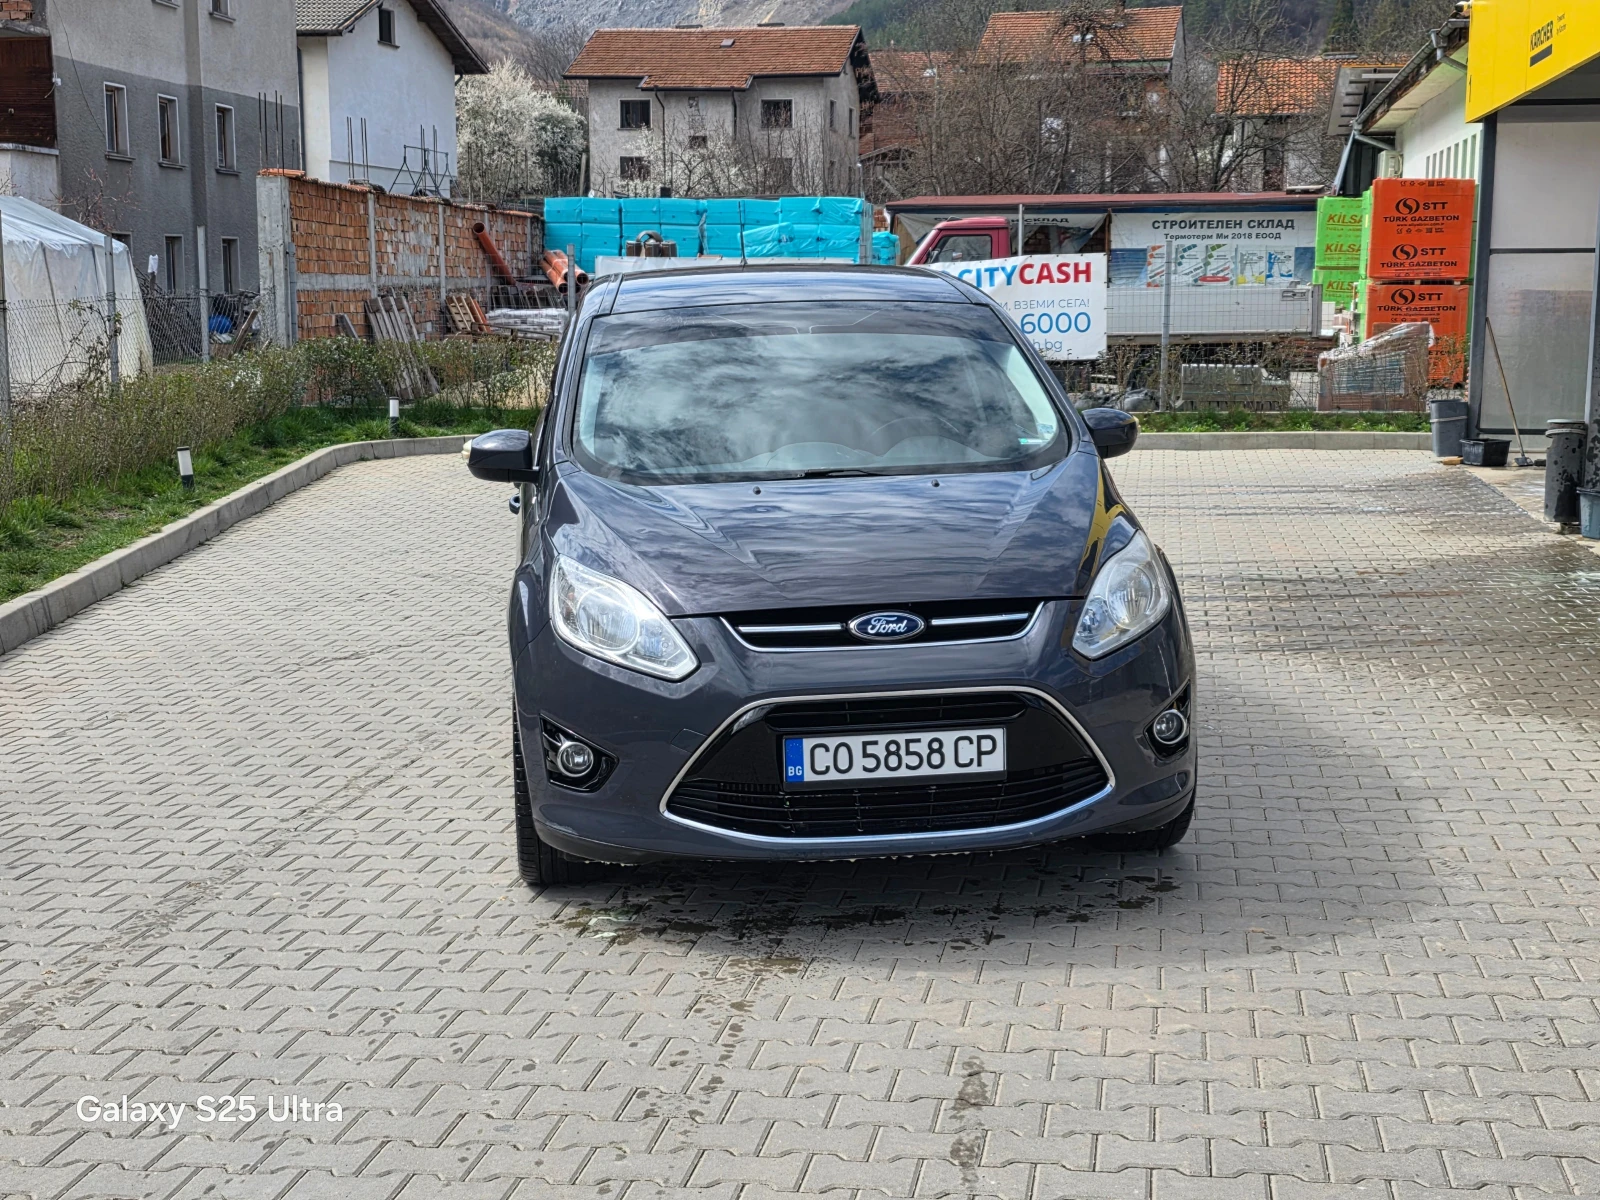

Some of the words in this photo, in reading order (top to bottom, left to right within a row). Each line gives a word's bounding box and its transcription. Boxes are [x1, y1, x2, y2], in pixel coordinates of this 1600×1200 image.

[1422, 202, 1448, 210] STT
[1152, 219, 1243, 230] СТРОИТЕЛЕН
[1247, 219, 1295, 230] СКЛАД
[1255, 232, 1281, 240] ЕООД
[1421, 248, 1446, 256] STT
[958, 262, 1092, 288] CITYCASH
[1326, 279, 1355, 290] KİLS
[1418, 293, 1443, 301] STT
[1014, 300, 1055, 310] ВЗЕМИ
[1058, 298, 1090, 309] СЕГА!
[867, 616, 907, 634] Ford
[788, 766, 803, 777] BG
[861, 737, 946, 773] 5858
[954, 734, 997, 769] CP
